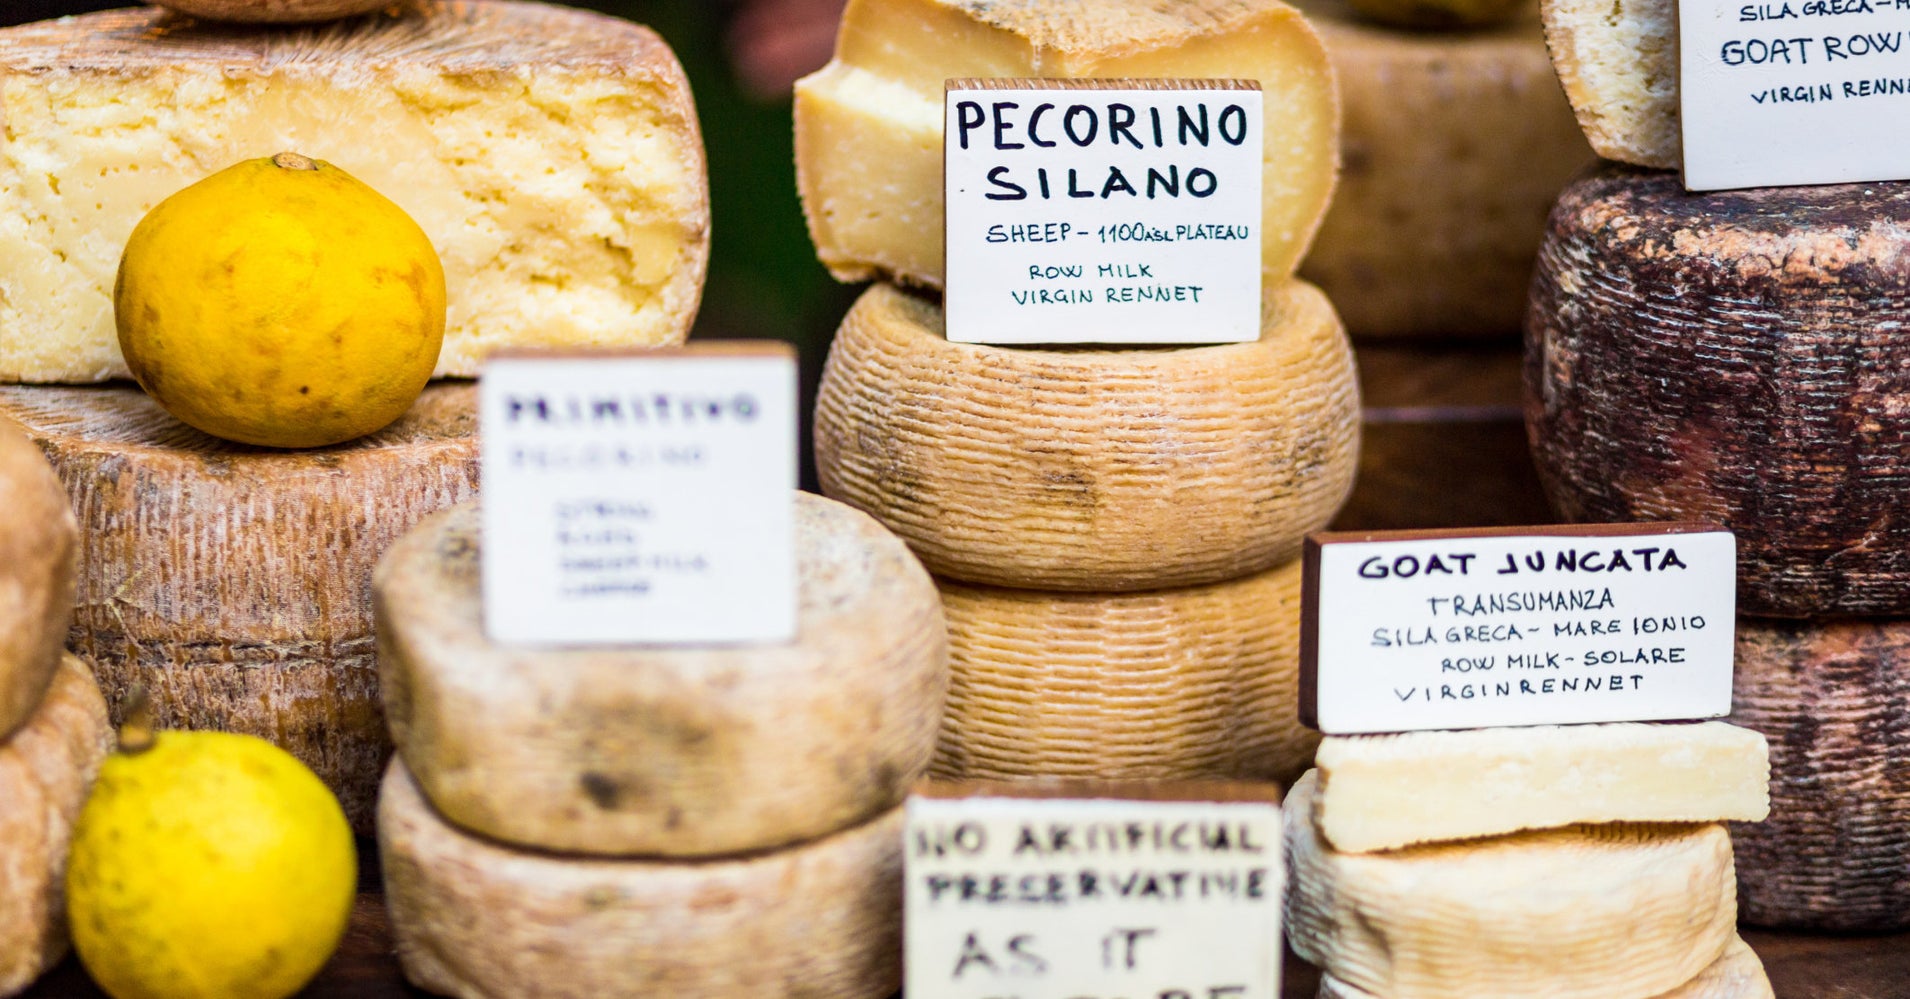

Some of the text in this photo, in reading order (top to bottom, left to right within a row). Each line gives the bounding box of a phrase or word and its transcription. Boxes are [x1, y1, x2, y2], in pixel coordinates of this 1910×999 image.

[1740, 2, 1798, 22] SILA
[1721, 32, 1901, 66] GOAT ROW
[1751, 78, 1910, 104] VIRGIN RENN
[956, 101, 1247, 150] PECORINO
[985, 164, 1217, 201] SILANO
[986, 223, 1071, 243] SHEEP
[1029, 264, 1153, 280] ROW MILK
[1012, 286, 1203, 305] VIRGIN RENNET
[1358, 547, 1687, 579] GOAT JUNCATA
[1427, 587, 1615, 617] TRANSUMANZA
[1371, 627, 1437, 647] SILA
[1554, 620, 1621, 637] MARE
[1633, 616, 1705, 635] IONIO
[1441, 656, 1494, 673] ROW
[1584, 648, 1685, 666] SOLARE
[915, 823, 986, 859] NO
[953, 928, 1157, 978] AS IT
